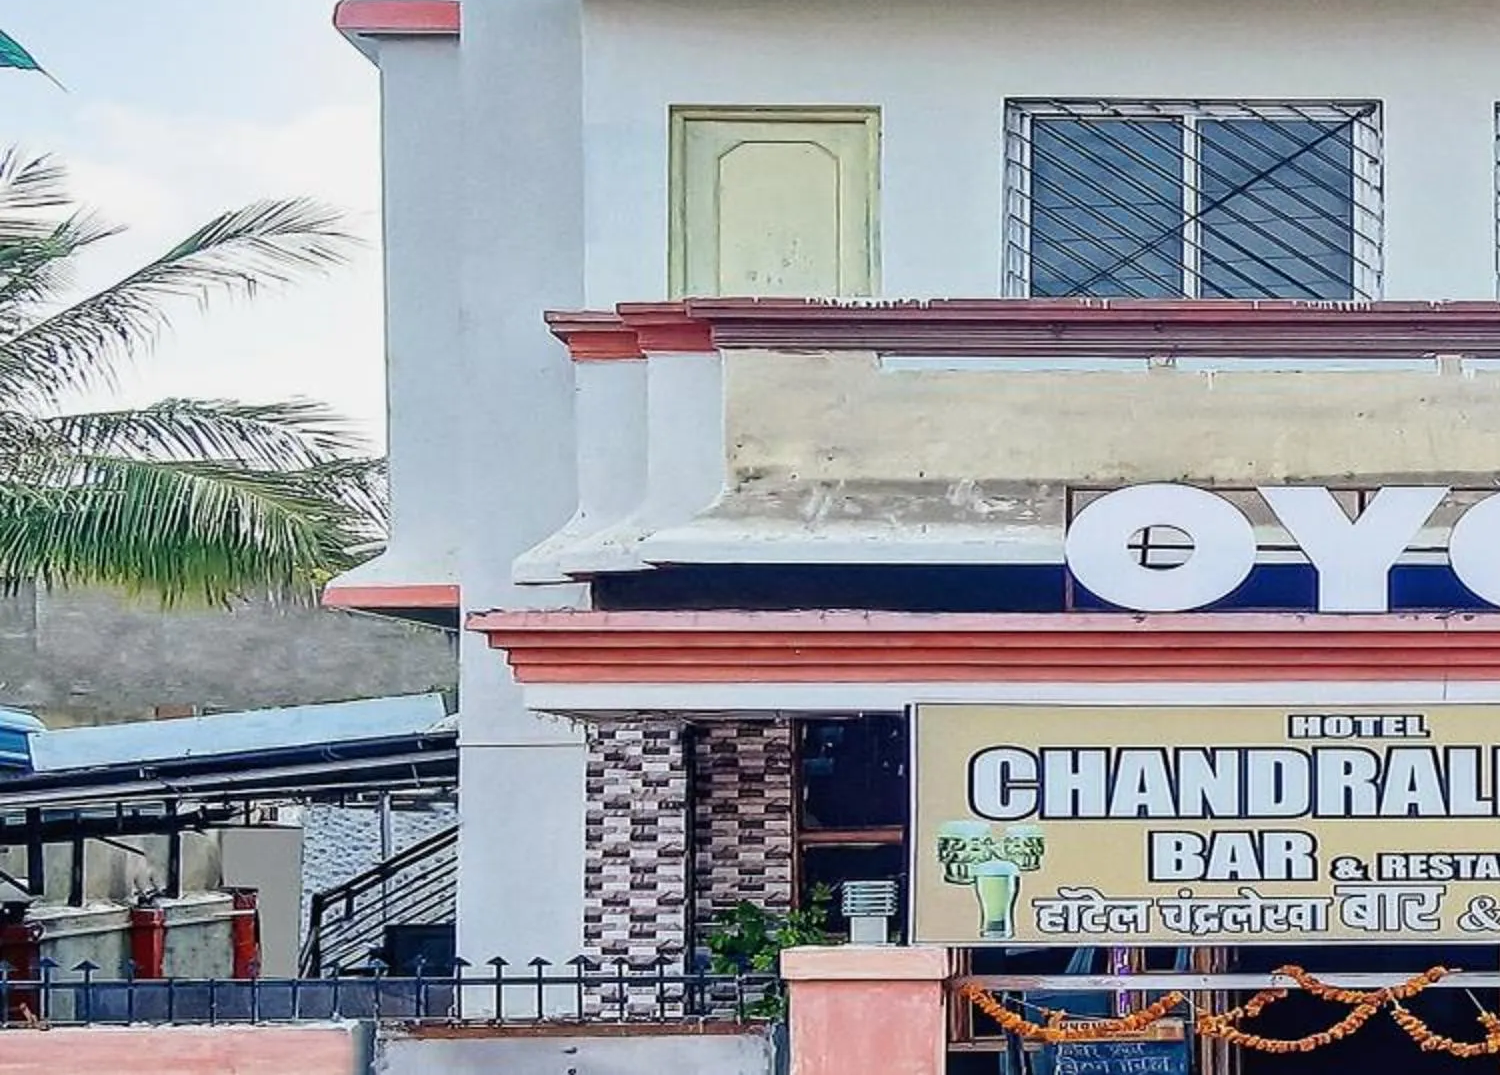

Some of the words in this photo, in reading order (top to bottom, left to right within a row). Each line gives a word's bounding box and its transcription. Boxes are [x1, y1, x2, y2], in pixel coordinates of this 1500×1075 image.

[1288, 714, 1431, 739] HOTEL
[1147, 829, 1319, 882] BAR
[1330, 855, 1369, 881] &
[1032, 887, 1154, 933] हॉटेल
[1157, 887, 1333, 936] चंद्रलेखा
[1334, 884, 1447, 932] बार
